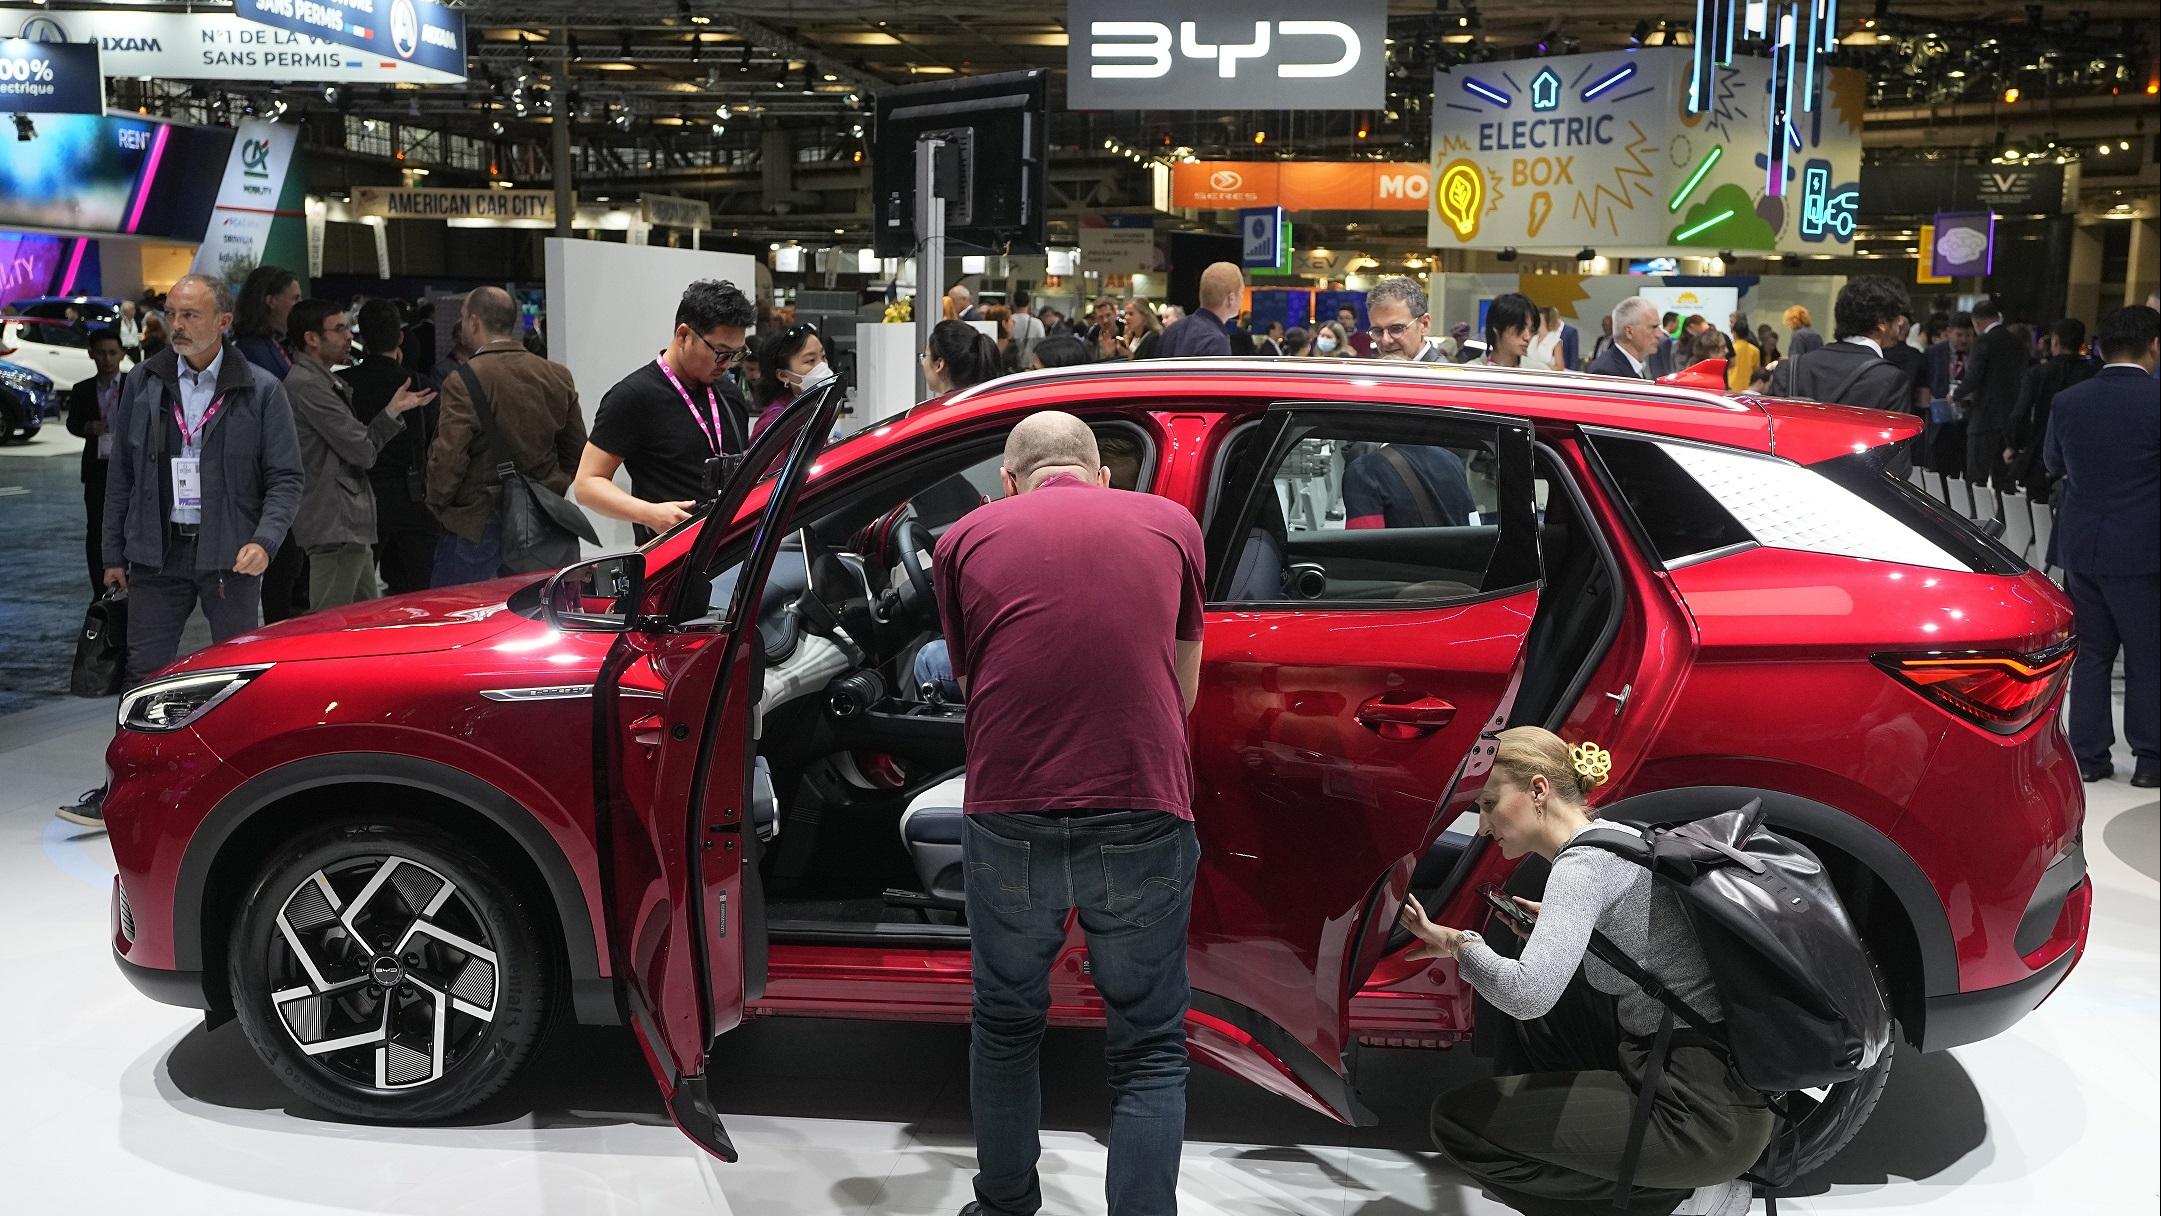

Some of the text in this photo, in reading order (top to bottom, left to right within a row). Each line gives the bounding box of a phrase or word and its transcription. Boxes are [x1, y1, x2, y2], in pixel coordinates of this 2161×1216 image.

[294, 0, 344, 31] PERMIS
[240, 30, 266, 44] DE
[274, 31, 300, 45] LA
[1091, 21, 1361, 78] BYD
[203, 51, 340, 67] SANS PERMIS
[1479, 114, 1614, 151] ELECTRIC
[1511, 155, 1574, 187] BOX
[1194, 192, 1257, 200] SERES
[1379, 174, 1429, 199] MO
[388, 192, 548, 216] AMERICAN CAR CITY
